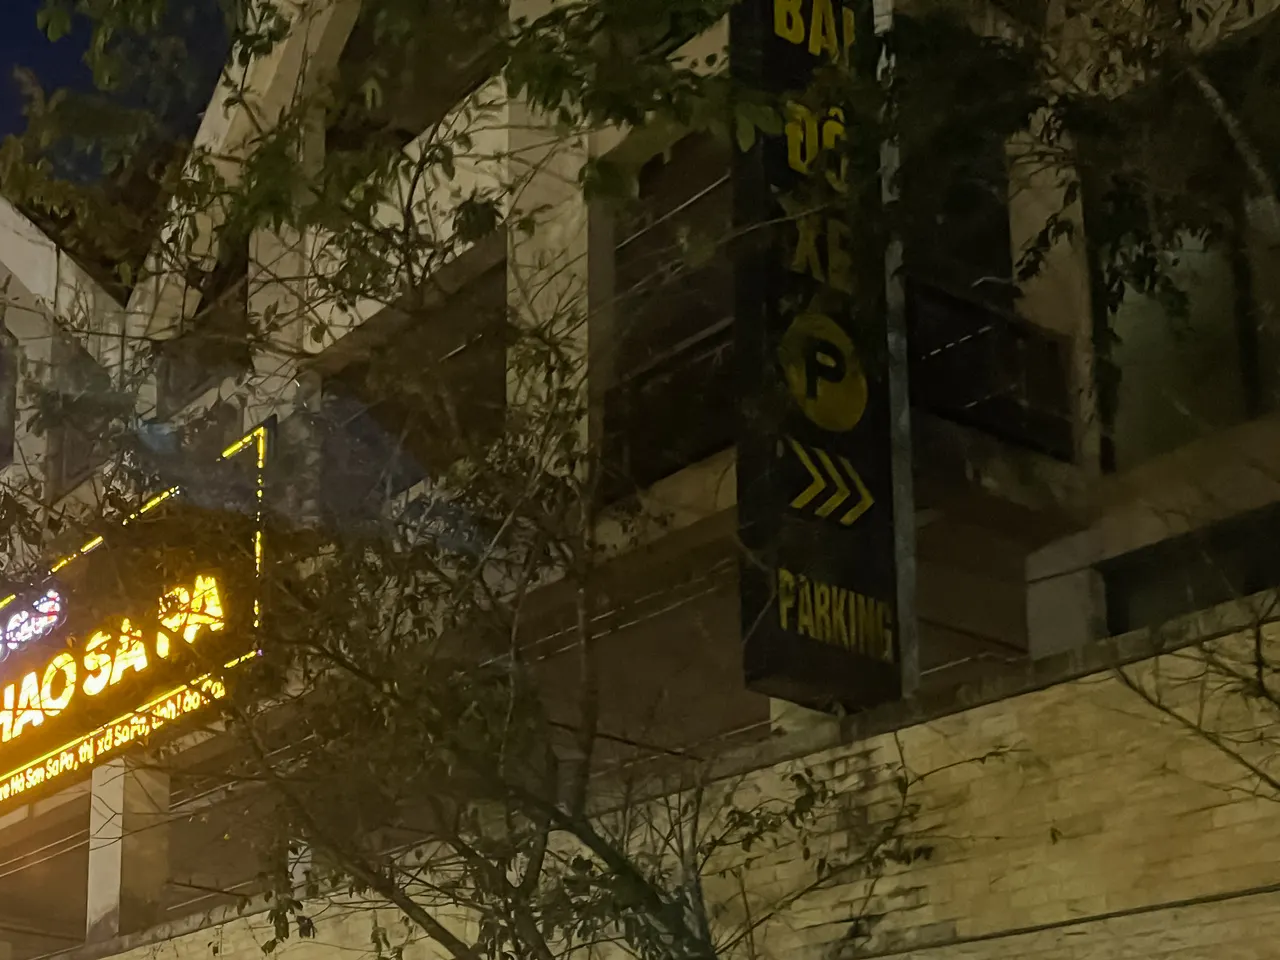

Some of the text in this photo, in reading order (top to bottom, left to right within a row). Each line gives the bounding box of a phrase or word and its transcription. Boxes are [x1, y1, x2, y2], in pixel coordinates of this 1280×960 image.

[82, 618, 148, 696] SA
[156, 575, 224, 659] PA
[778, 566, 894, 664] PARKING
